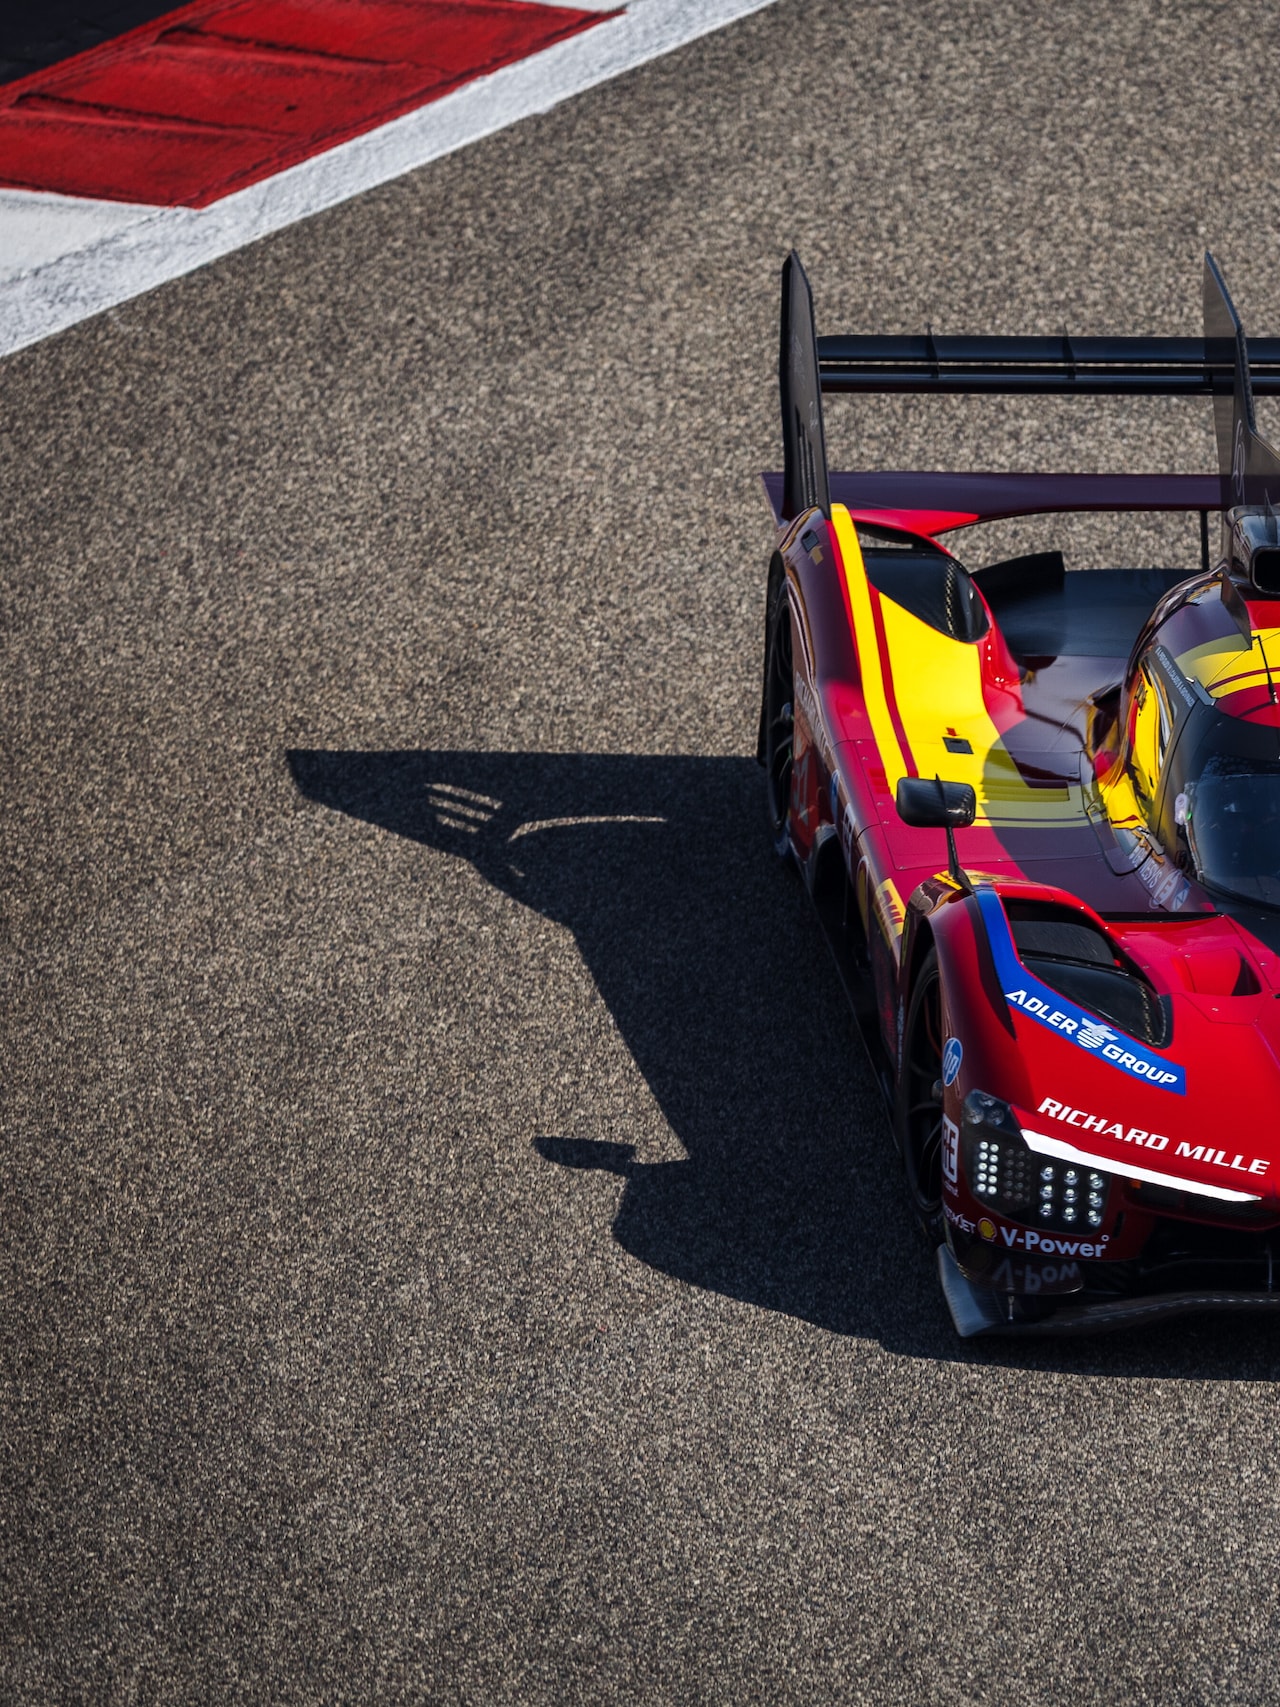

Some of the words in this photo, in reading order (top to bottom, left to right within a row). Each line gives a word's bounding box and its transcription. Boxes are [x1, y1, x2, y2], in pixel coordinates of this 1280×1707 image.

[1005, 989, 1077, 1035] ADLER
[1102, 1043, 1178, 1085] GROUP
[1037, 1097, 1170, 1150] RICHARD
[1174, 1141, 1270, 1175] MILLE
[1000, 1226, 1106, 1257] V-Power
